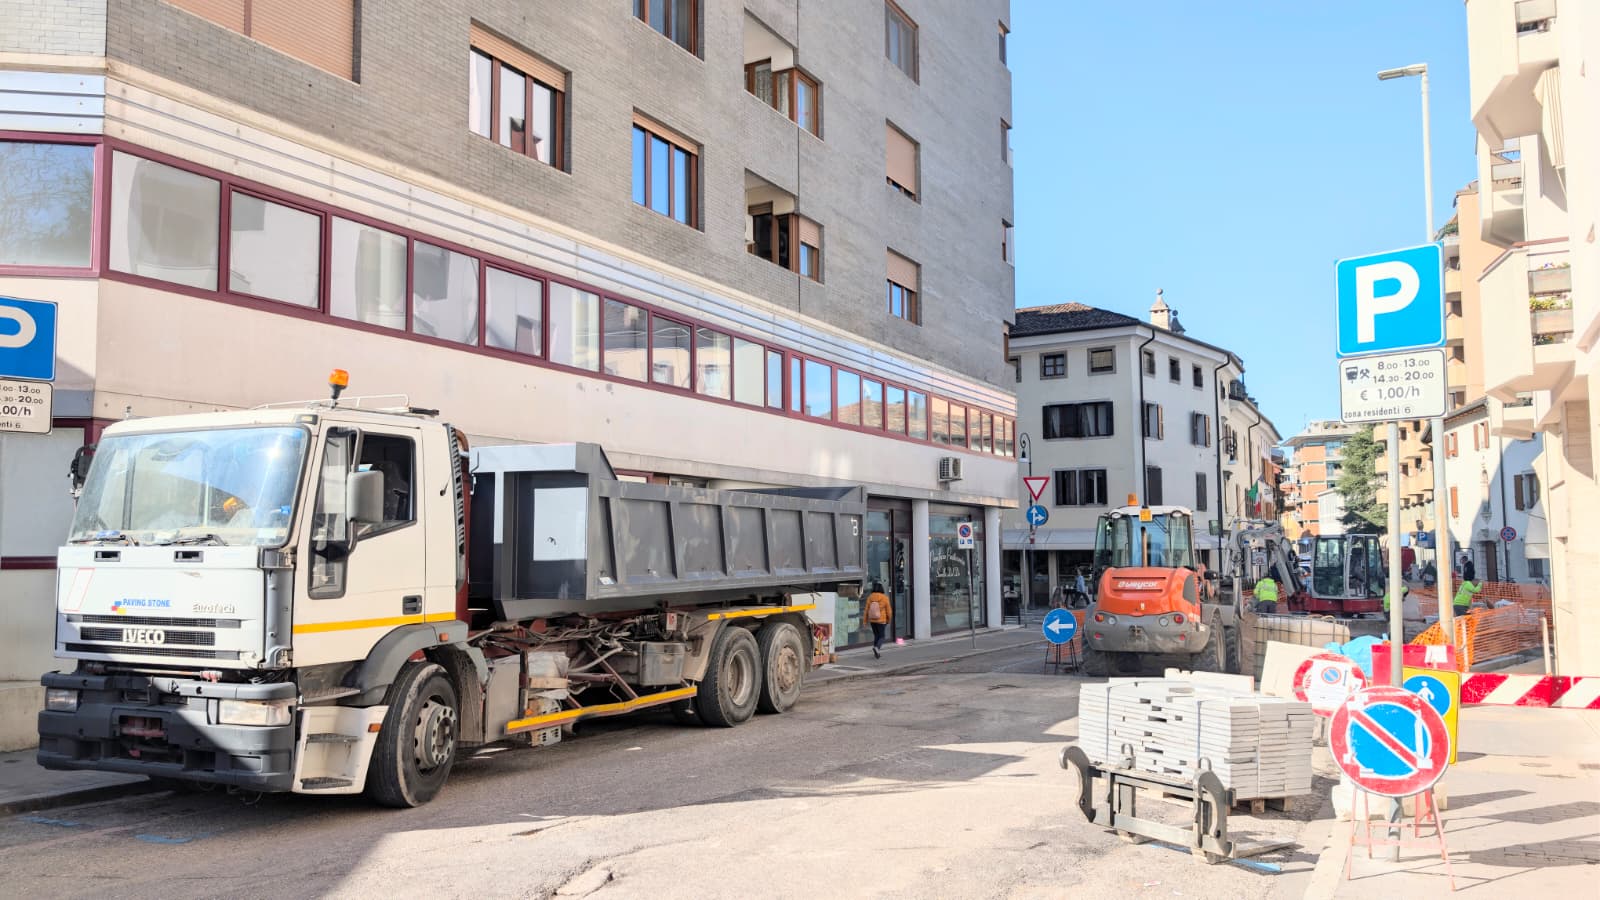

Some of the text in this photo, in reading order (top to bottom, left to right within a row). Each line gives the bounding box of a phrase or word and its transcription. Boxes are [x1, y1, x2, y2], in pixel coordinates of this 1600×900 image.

[1356, 261, 1420, 344] P
[1360, 385, 1420, 401] € 1,00/h
[1344, 406, 1411, 418] zona residenti 6
[123, 598, 170, 607] PAVING STONE
[122, 628, 165, 645] IVECO
